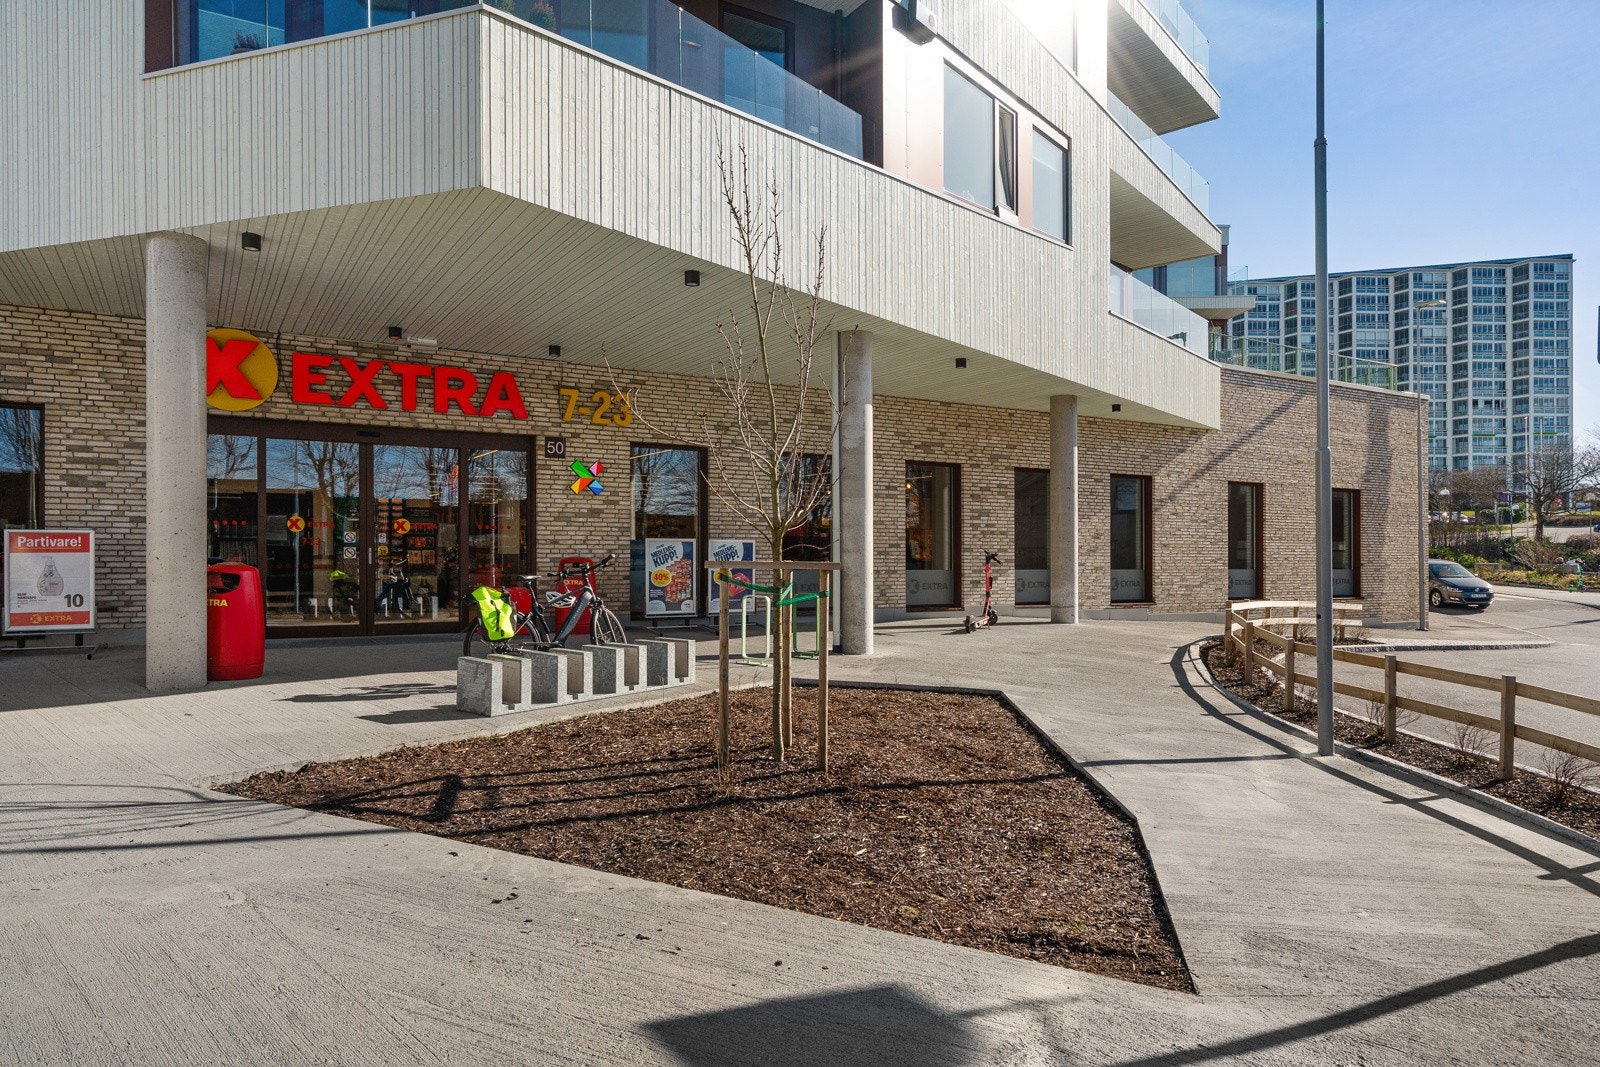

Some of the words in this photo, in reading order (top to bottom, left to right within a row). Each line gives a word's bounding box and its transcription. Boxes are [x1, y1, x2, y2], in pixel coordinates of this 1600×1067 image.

[291, 352, 529, 420] EXTRA
[560, 388, 634, 427] 7-23
[546, 441, 564, 455] 50
[17, 536, 82, 548] Partivare!
[653, 550, 678, 567] KUPP!
[654, 573, 669, 581] 40%
[1121, 580, 1140, 588] EXTRA
[921, 582, 948, 590] EXTRA
[63, 593, 84, 608] 10
